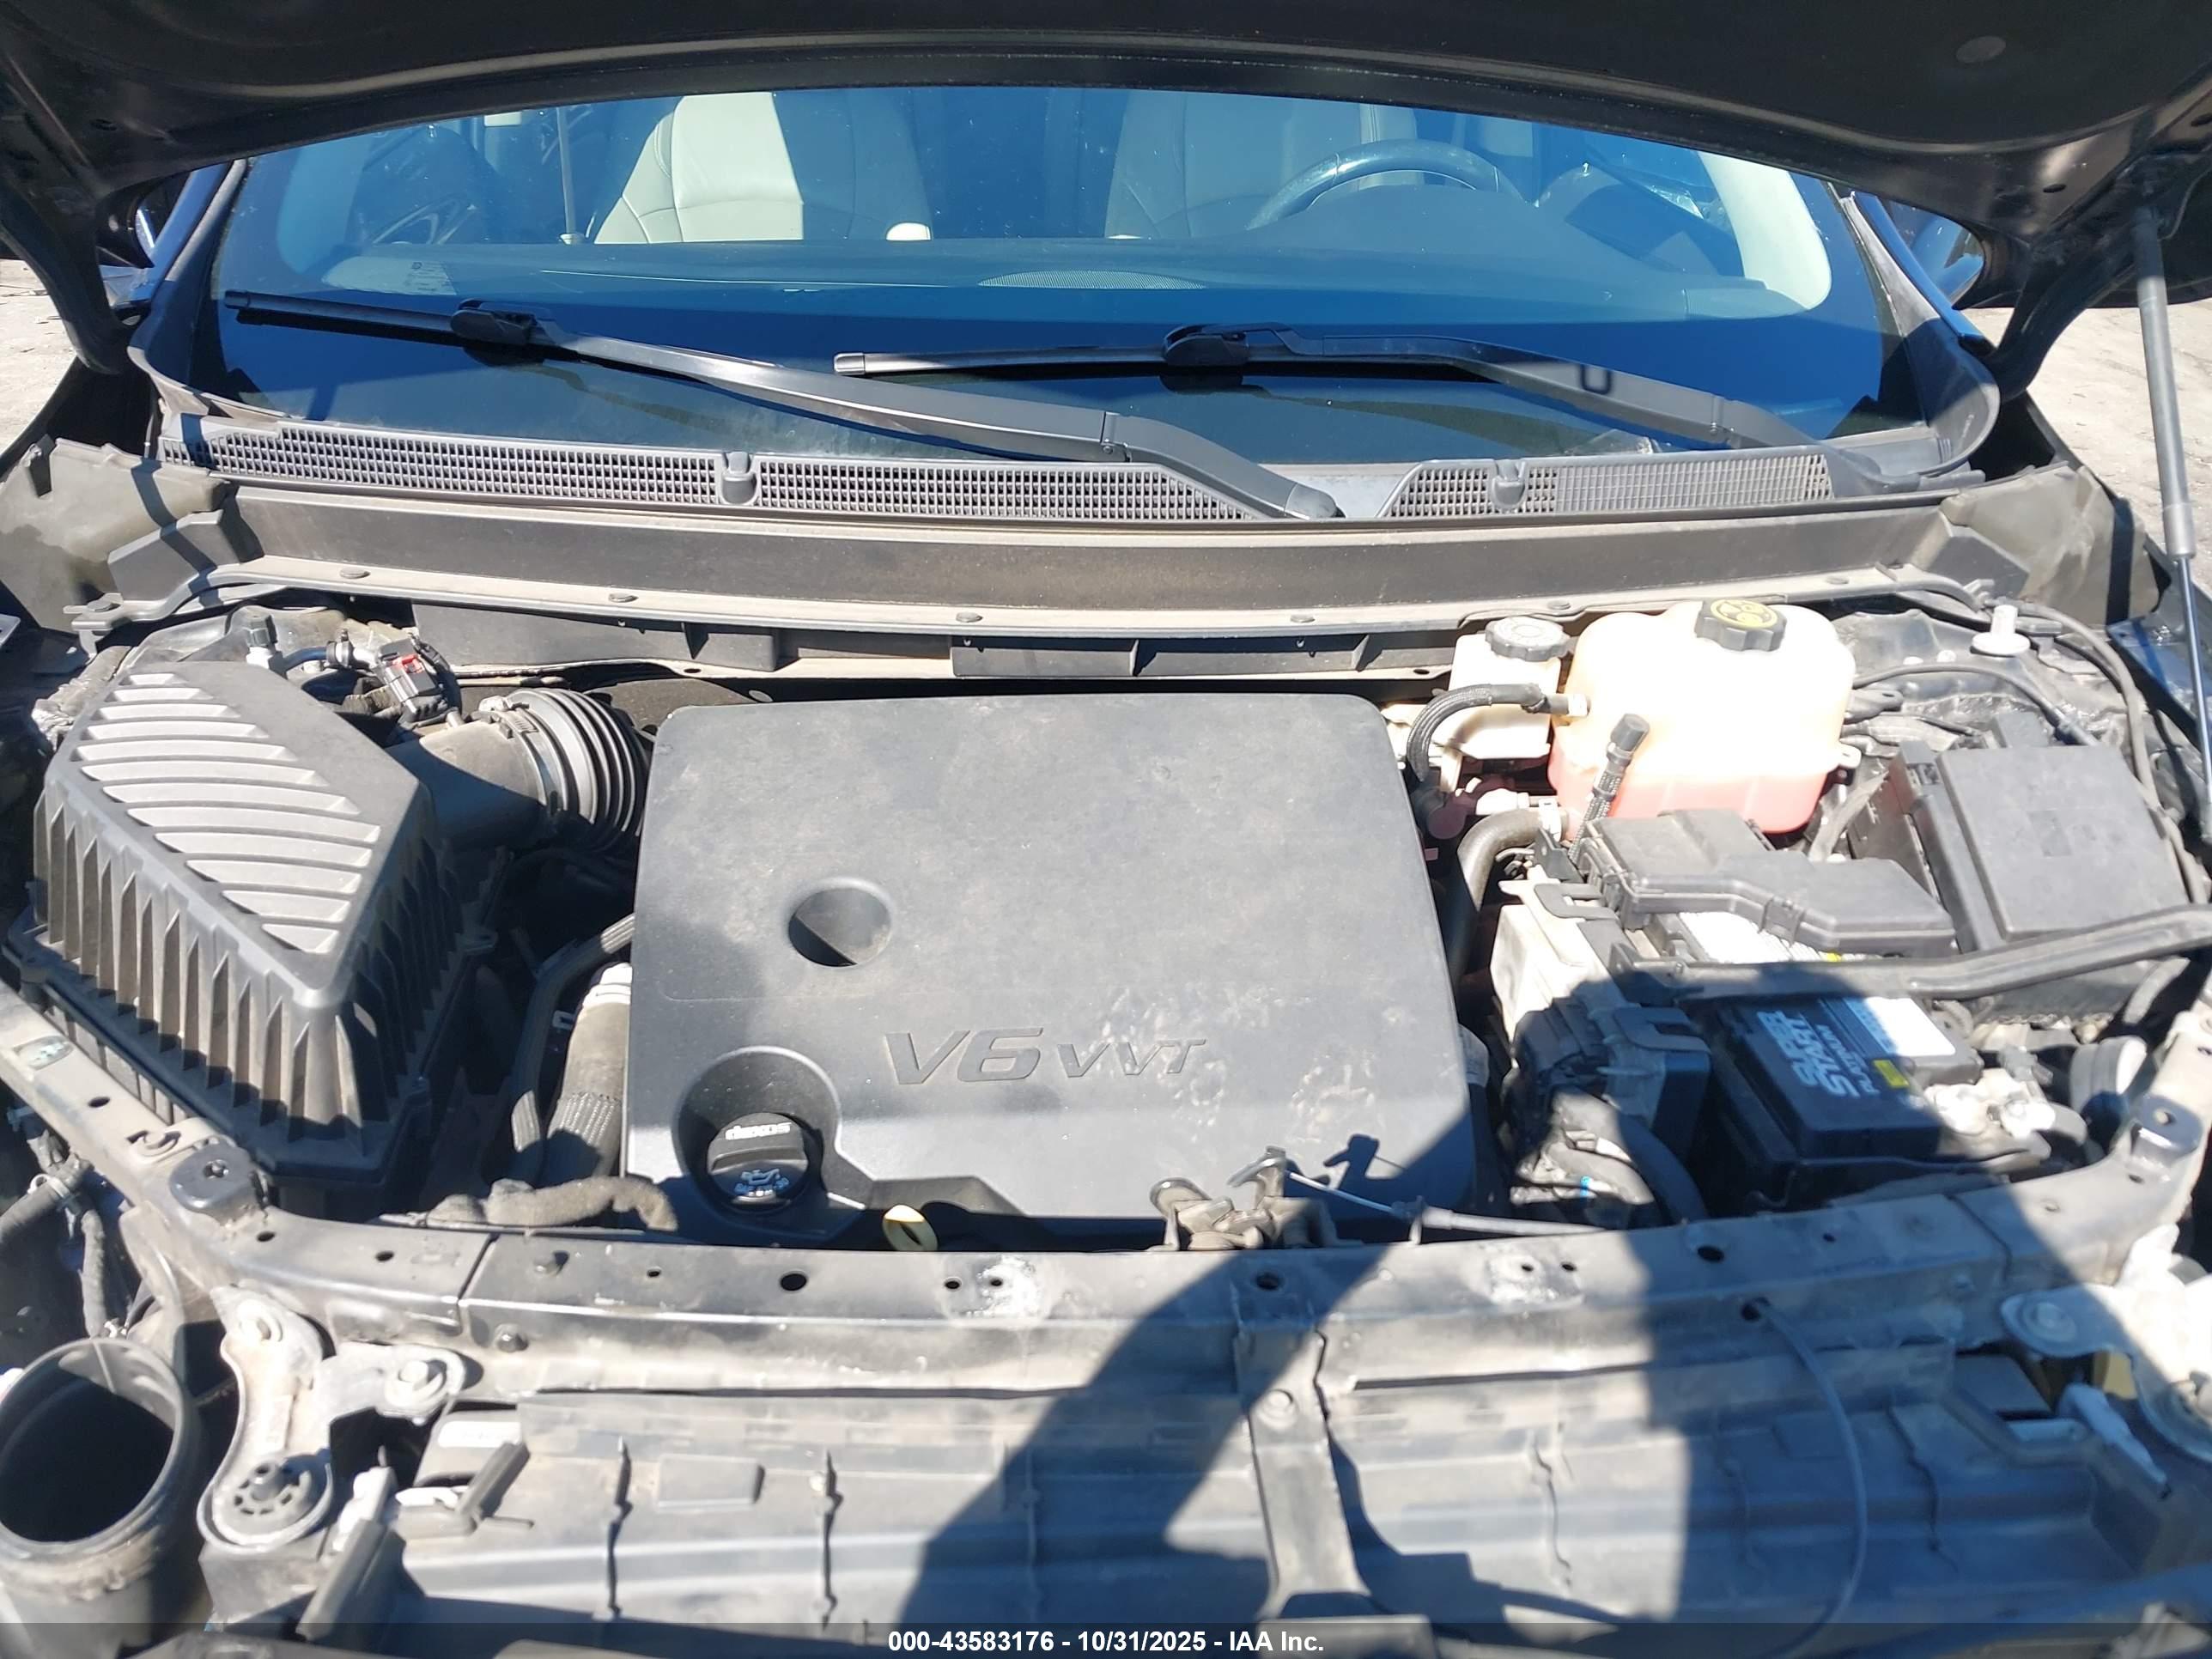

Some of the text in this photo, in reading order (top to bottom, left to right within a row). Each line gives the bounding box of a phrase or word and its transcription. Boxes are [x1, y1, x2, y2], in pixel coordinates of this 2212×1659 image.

[884, 1027, 1206, 1085] V6 VVT
[1756, 1010, 1818, 1086] SUPER
[1785, 1016, 1861, 1098] START
